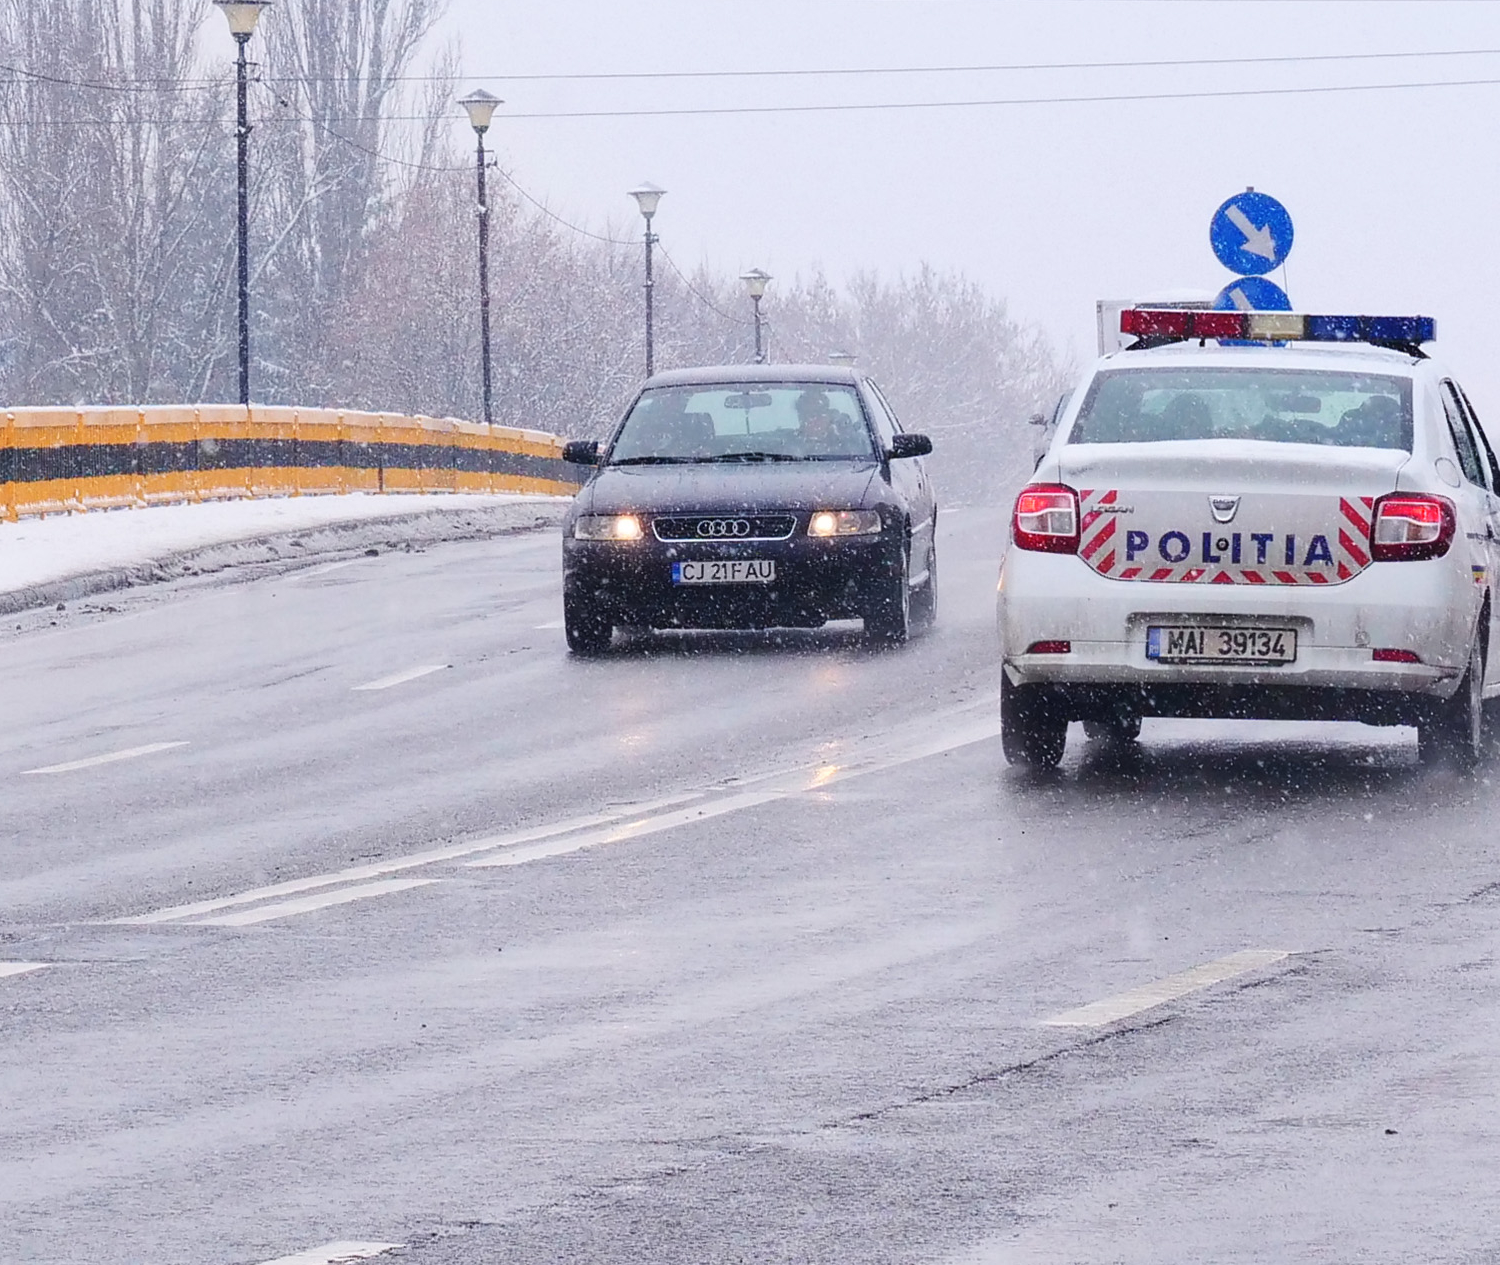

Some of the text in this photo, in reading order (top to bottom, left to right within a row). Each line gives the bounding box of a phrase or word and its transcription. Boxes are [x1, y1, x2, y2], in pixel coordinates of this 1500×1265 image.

[1126, 530, 1334, 566] POLITIA
[683, 563, 705, 580] CJ
[1167, 630, 1286, 657] MAI 39134
